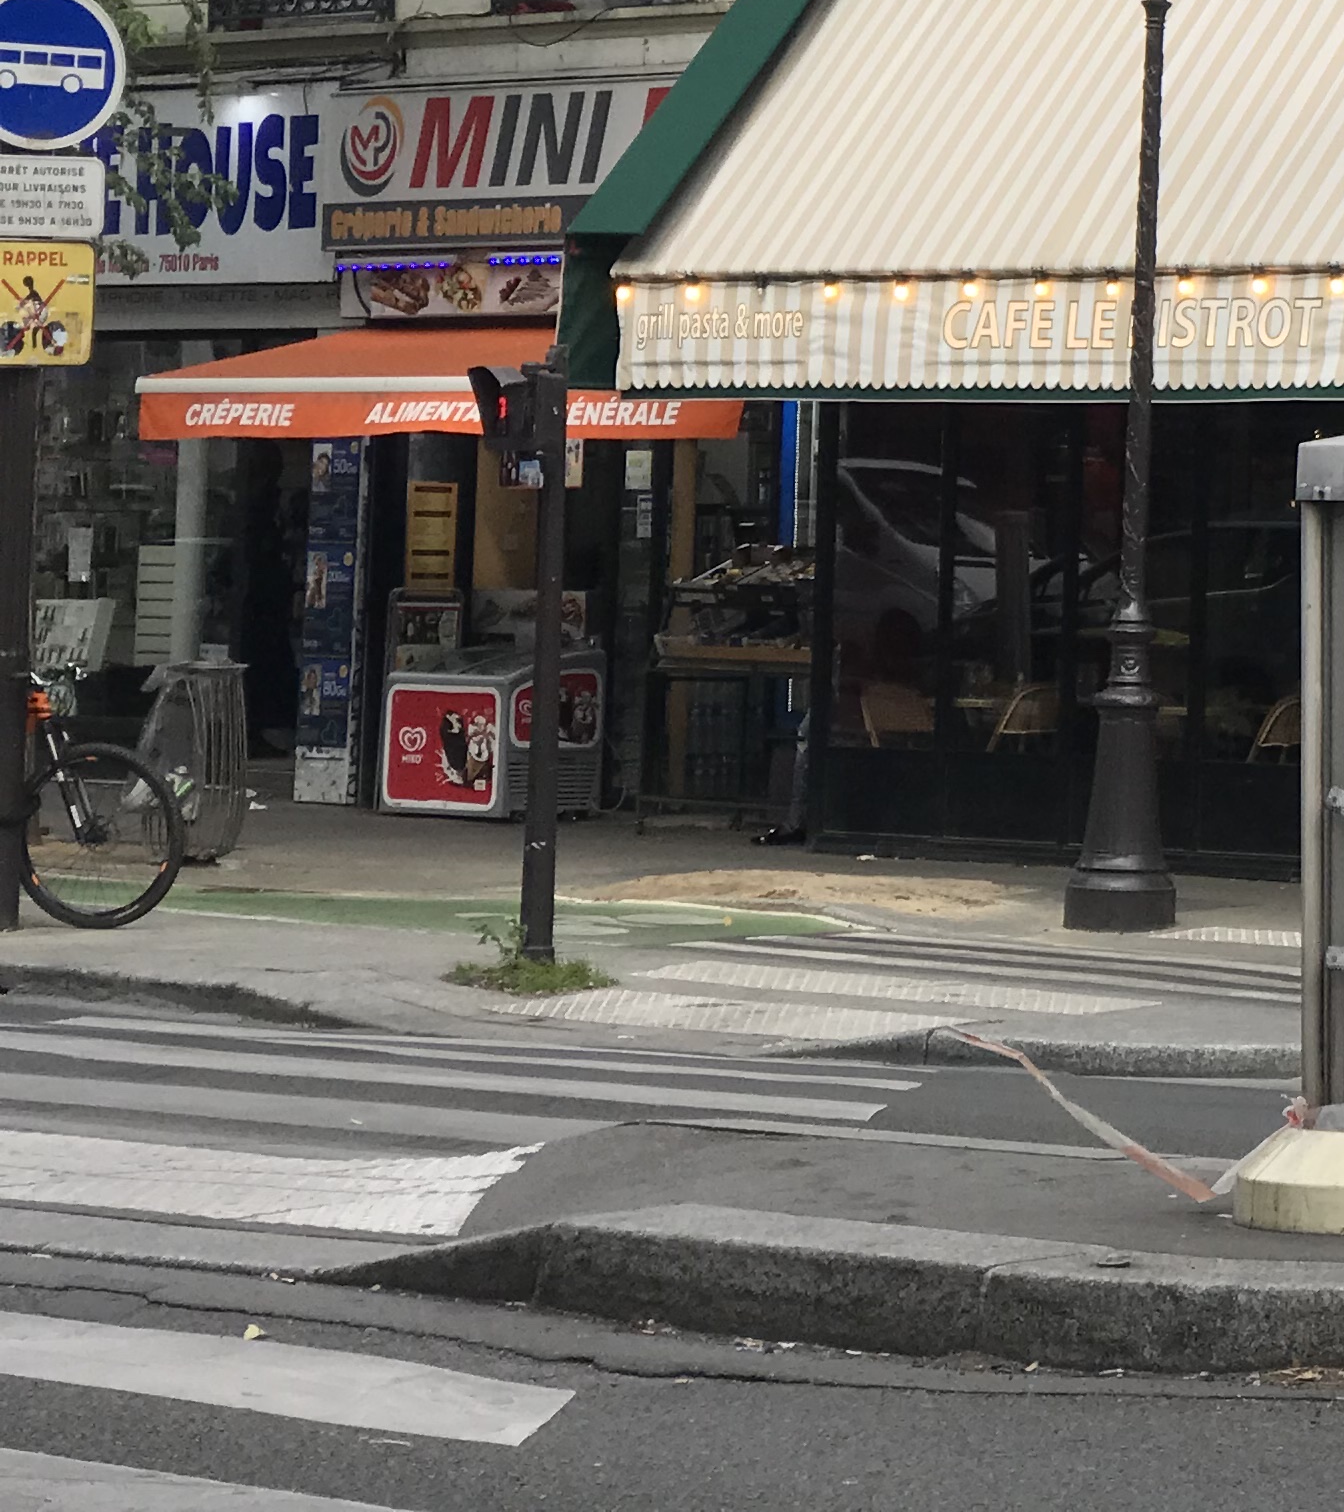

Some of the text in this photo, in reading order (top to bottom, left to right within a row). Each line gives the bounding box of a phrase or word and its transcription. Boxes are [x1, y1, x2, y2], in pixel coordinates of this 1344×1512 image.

[409, 90, 613, 188] MINI
[0, 164, 85, 176] RRÊT AUTORISÉ
[0, 182, 87, 194] OUR LIVRAISONS
[3, 251, 68, 267] RAPPEL
[159, 254, 190, 272] 75010
[192, 252, 219, 272] Paris
[636, 302, 804, 350] grill pasta & more
[943, 297, 1323, 350] CAFE LE ISTROT
[185, 398, 294, 426] CRÊPERIE
[364, 397, 681, 426] ALIMENTA ÉNÉRALE
